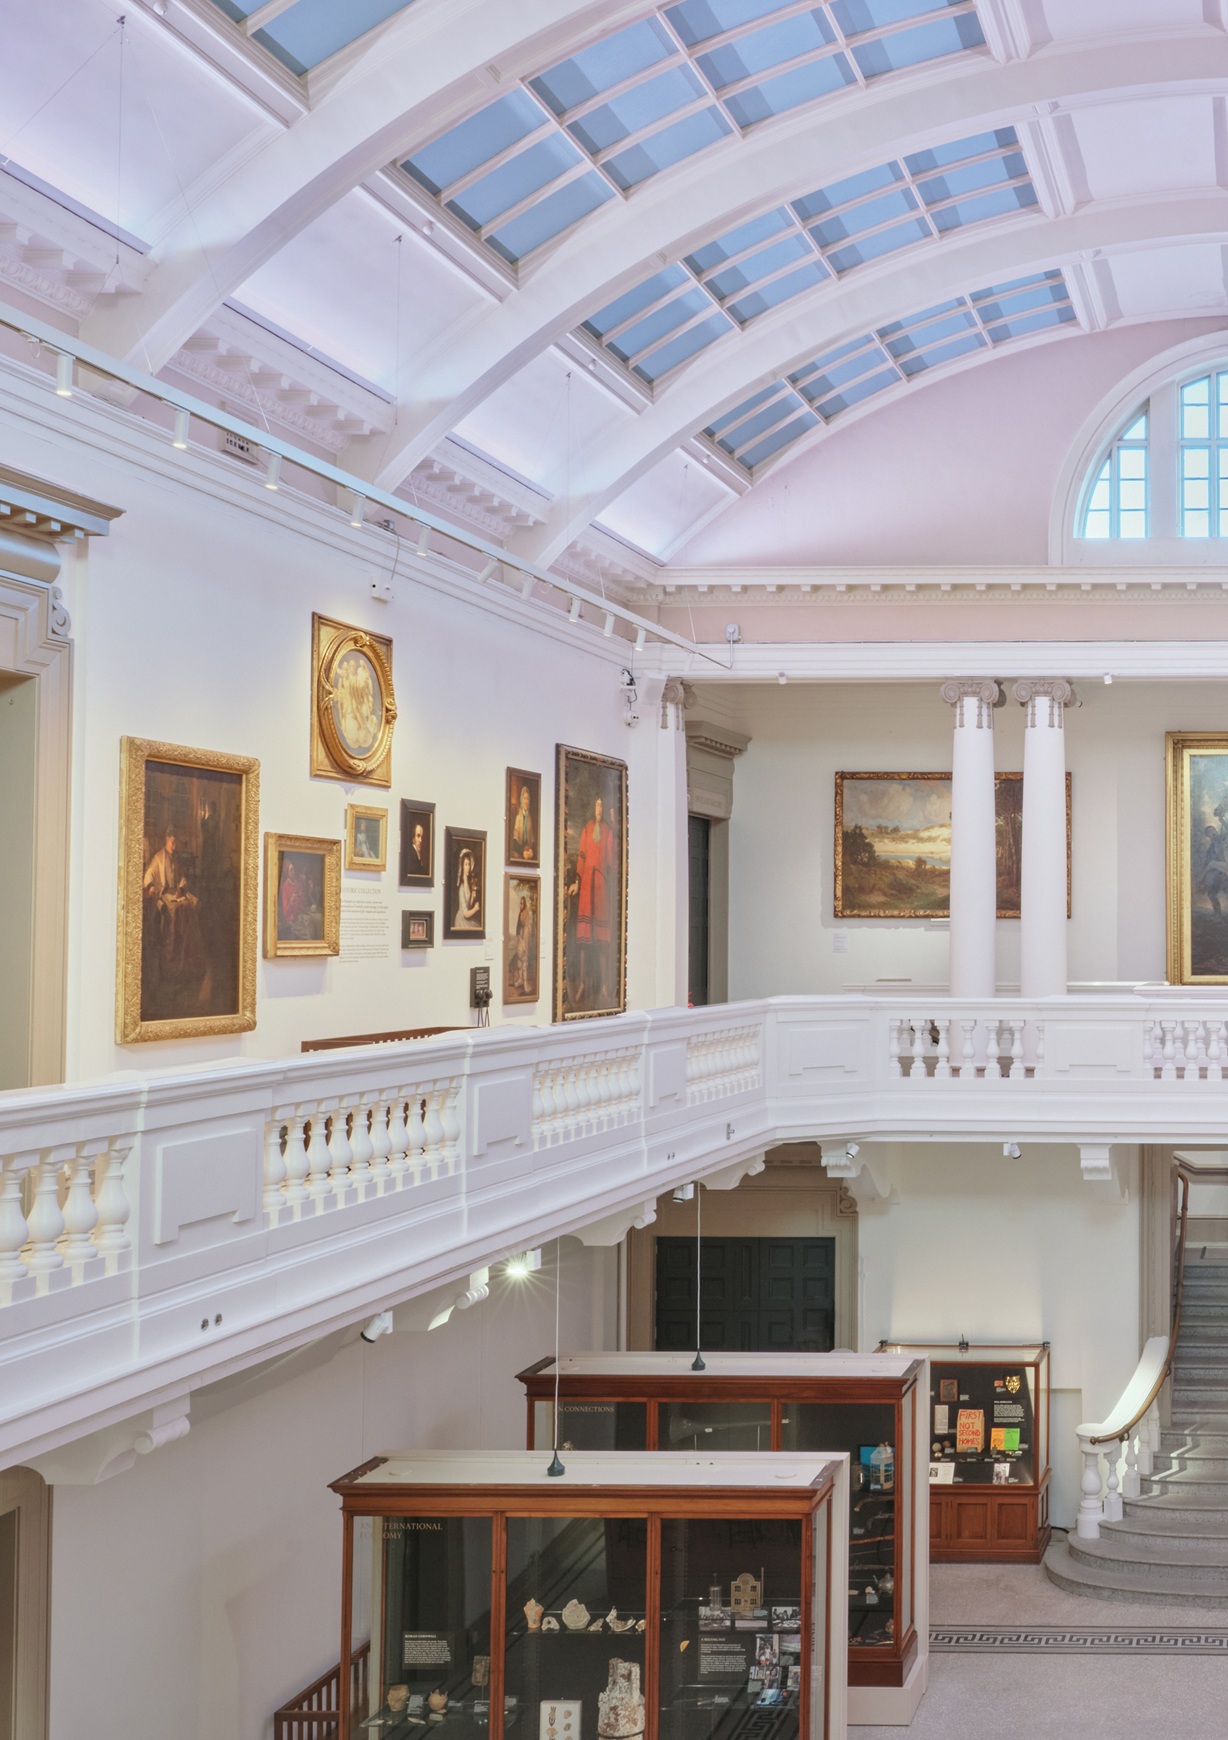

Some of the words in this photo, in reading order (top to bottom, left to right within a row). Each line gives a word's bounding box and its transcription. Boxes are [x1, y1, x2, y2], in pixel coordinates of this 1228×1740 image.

[959, 1410, 982, 1420] FIRST
[959, 1422, 975, 1430] NOT
[959, 1429, 981, 1437] SECOND
[958, 1437, 981, 1446] HOMES
